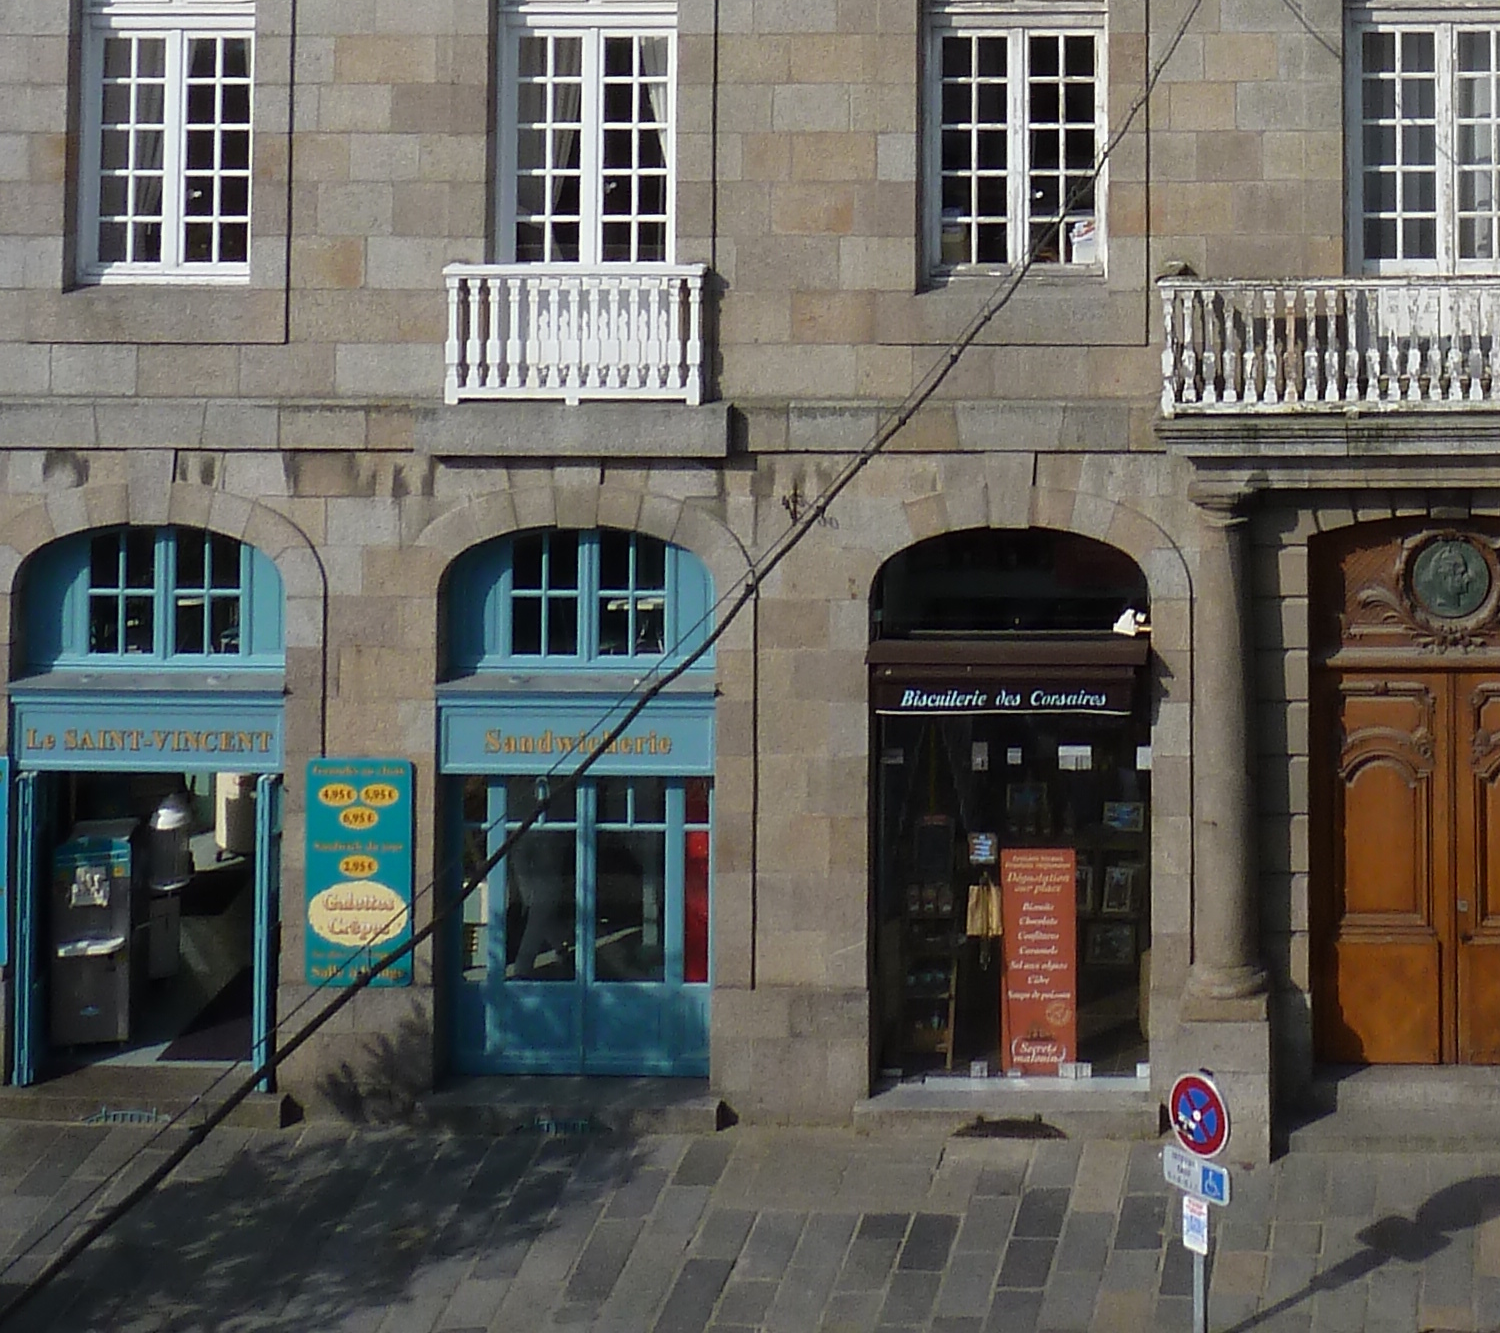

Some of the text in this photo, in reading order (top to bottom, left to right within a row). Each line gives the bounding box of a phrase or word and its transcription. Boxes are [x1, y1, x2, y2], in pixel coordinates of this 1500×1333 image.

[900, 688, 1108, 708] Biscuiterie des Corsaires
[26, 728, 274, 754] Le SAINT-VINCENT
[484, 728, 673, 755] Sandwicherie
[322, 892, 396, 912] Galettes
